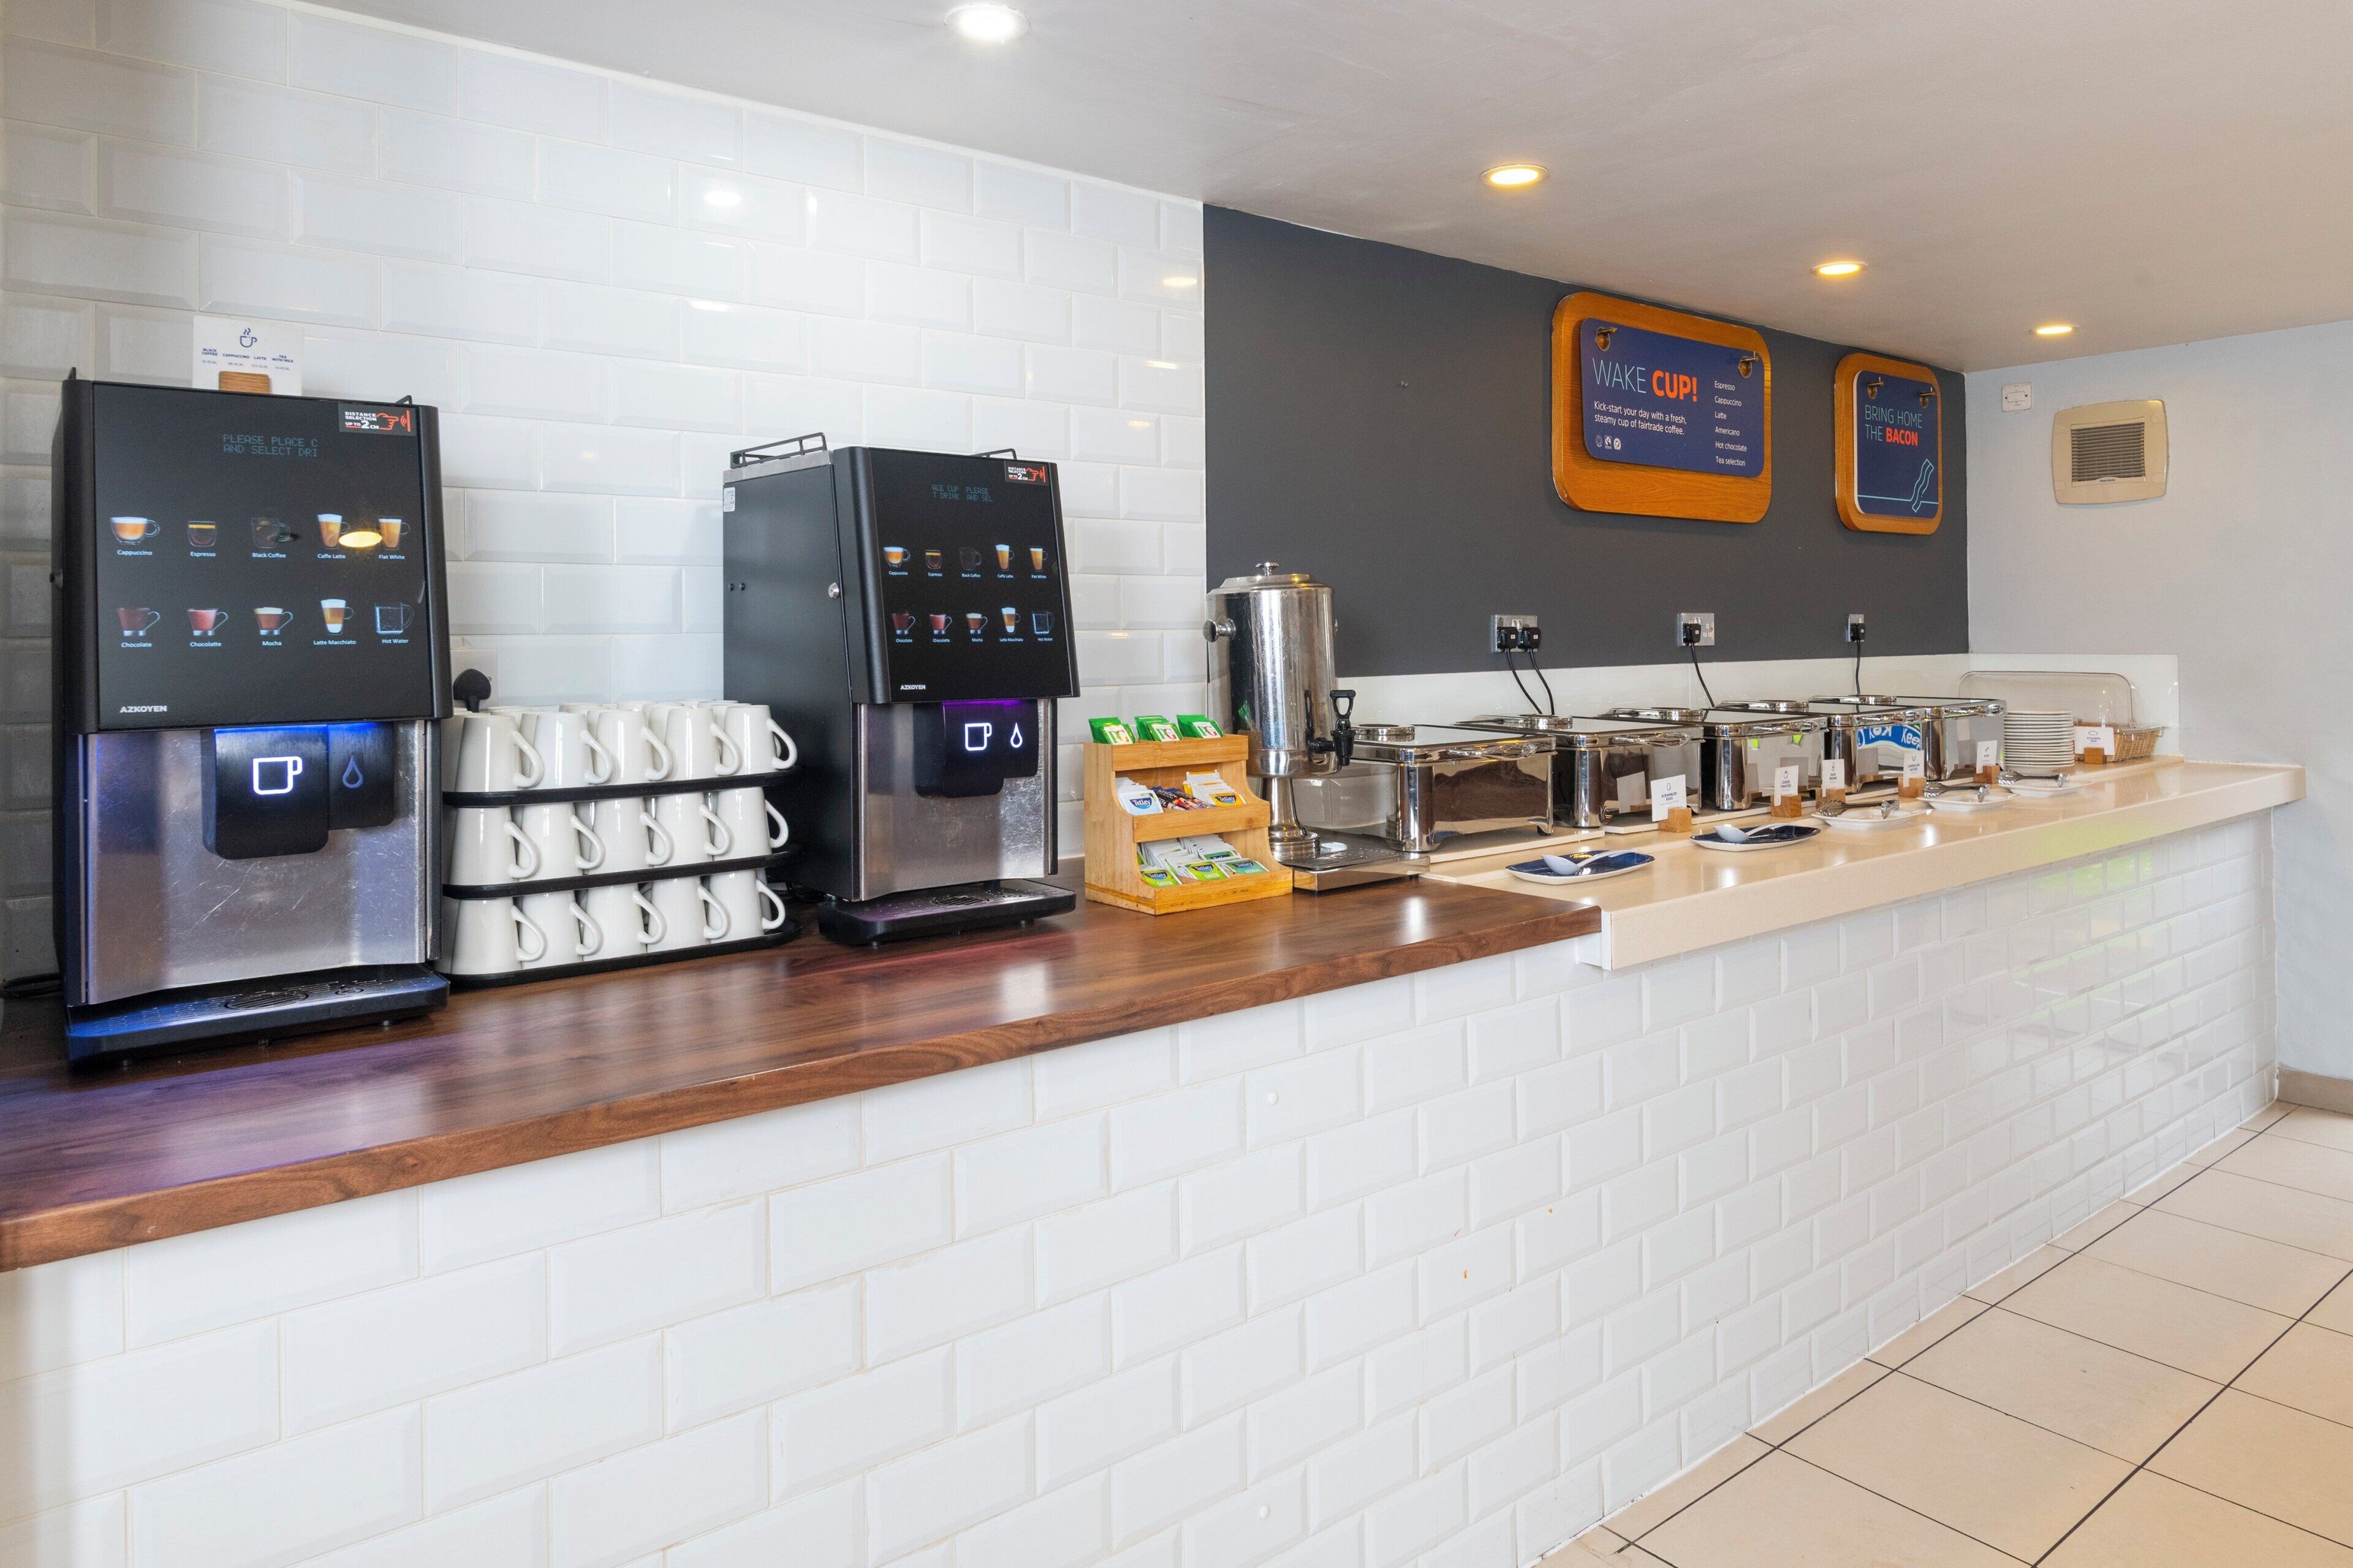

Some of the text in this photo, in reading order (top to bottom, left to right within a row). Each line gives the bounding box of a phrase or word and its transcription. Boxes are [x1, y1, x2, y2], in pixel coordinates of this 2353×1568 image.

[1593, 357, 1697, 402] WAKE CUP!
[1715, 381, 1735, 391] Espresso
[1715, 396, 1741, 407] Cappuccino
[1594, 400, 1622, 414] Kick-start
[1639, 409, 1650, 419] day
[1651, 411, 1664, 420] with
[1670, 413, 1686, 425] fresh,
[1715, 411, 1727, 420] Latte
[1865, 404, 1922, 428] BRING HOME
[361, 420, 369, 429] 2
[1594, 414, 1684, 435] steamy cup of fairtrade coffee.
[1715, 426, 1740, 436] Americano
[1865, 424, 1919, 446] THE BACON
[223, 434, 318, 447] PLEASE PLACE C
[224, 444, 317, 457] AND SELECT DRI
[1725, 442, 1747, 452] chocolate
[1108, 730, 1130, 743] PG
[1156, 728, 1177, 740] PG
[1197, 725, 1218, 737] PG
